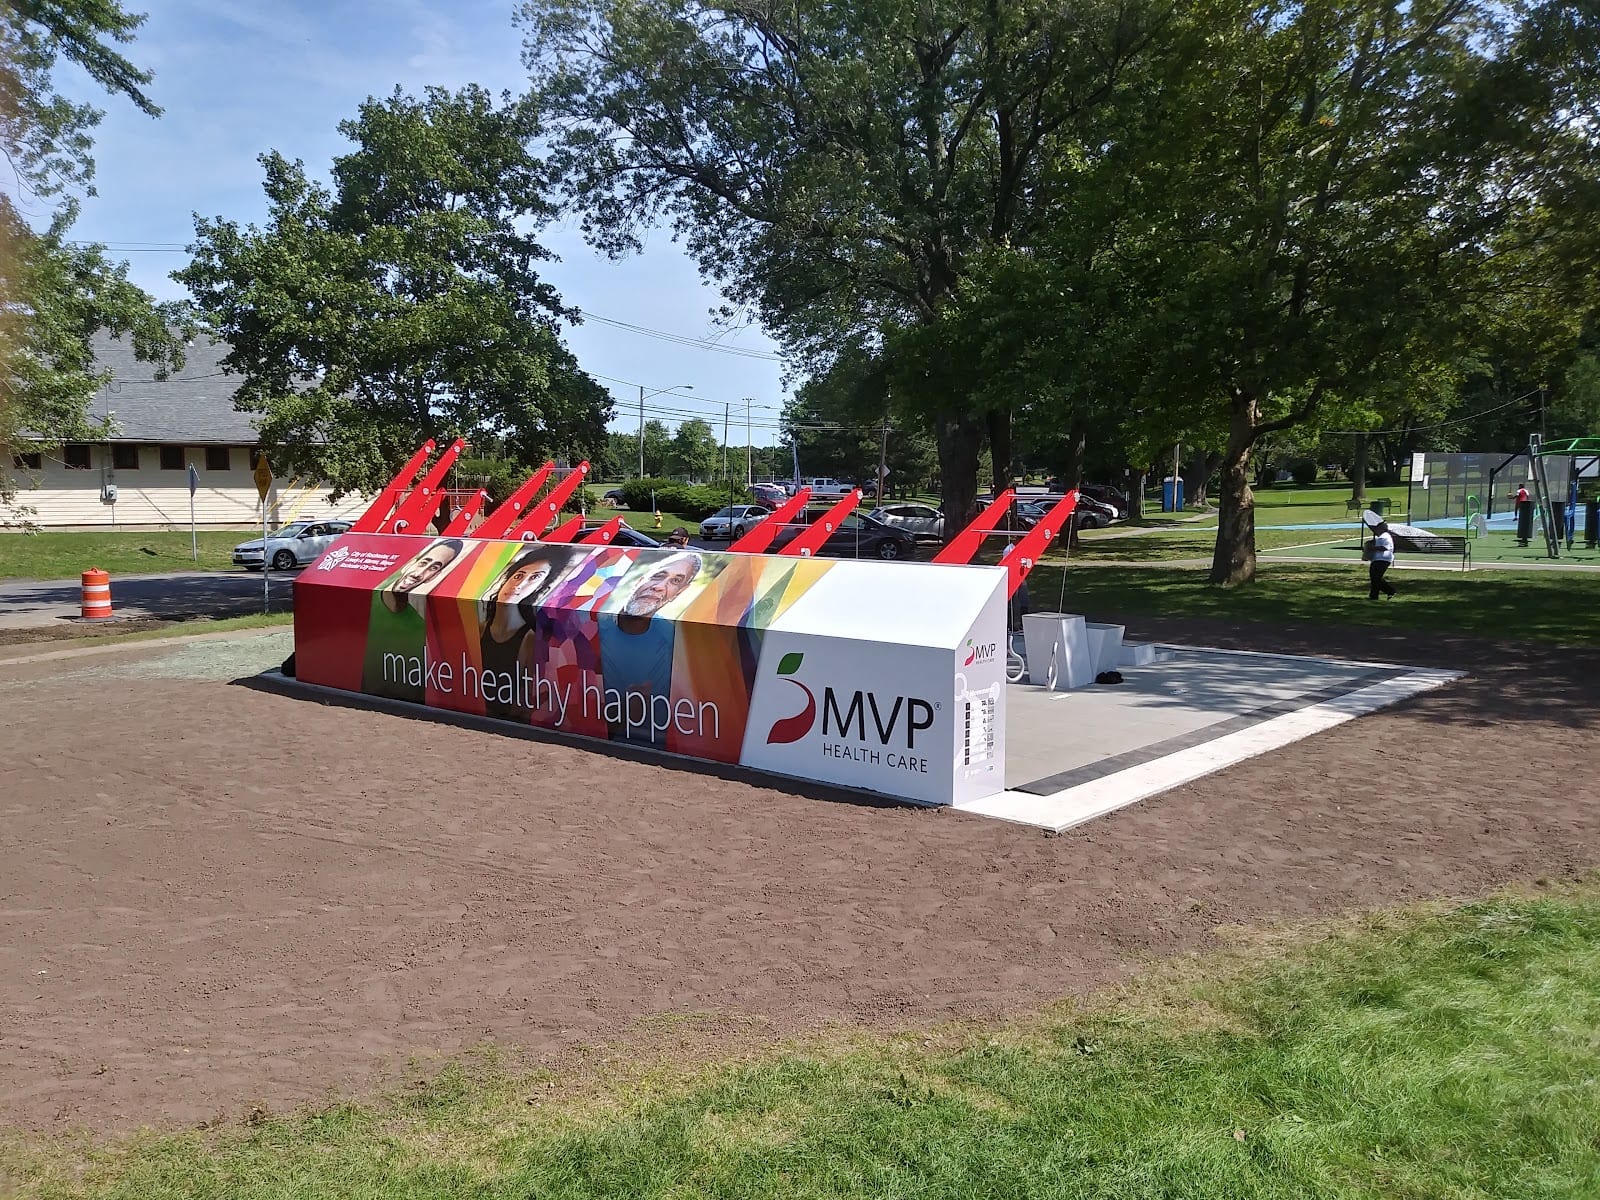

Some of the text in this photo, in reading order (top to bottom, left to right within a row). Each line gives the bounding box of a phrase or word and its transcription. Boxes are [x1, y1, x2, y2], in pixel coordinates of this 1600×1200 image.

[976, 643, 995, 660] MVP
[383, 645, 719, 743] make healthy happen
[823, 742, 928, 774] HEALTH CARE
